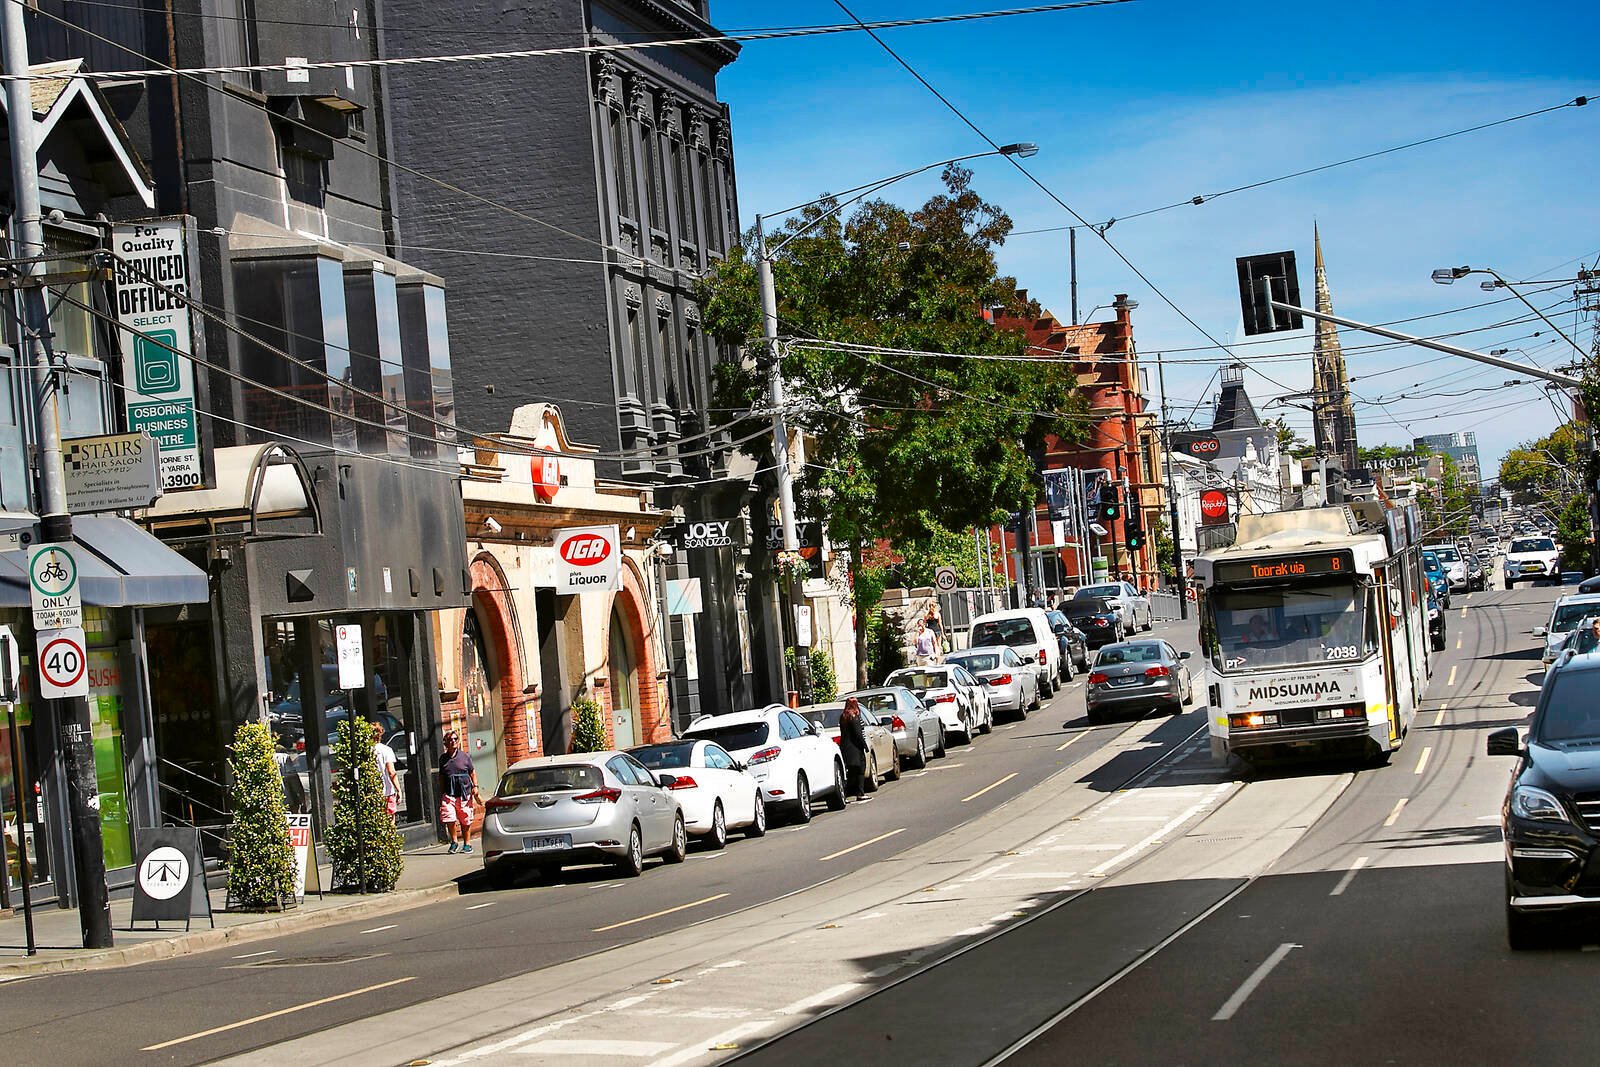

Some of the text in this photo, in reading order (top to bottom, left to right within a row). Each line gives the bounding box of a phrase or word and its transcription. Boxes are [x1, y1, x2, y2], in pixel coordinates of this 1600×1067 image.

[134, 226, 159, 237] For
[122, 238, 174, 252] Quality
[117, 255, 183, 285] SERVICED
[119, 284, 185, 315] OFFICES
[133, 315, 173, 326] SELECT
[134, 404, 187, 418] OSBORNE
[135, 419, 188, 432] BUSINESS
[156, 434, 184, 446] NTRE
[81, 439, 142, 461] STAIRS
[82, 457, 142, 469] HAIR SALON
[167, 465, 191, 473] YARRA
[10, 532, 18, 541] ST
[684, 521, 730, 539] JOEY
[766, 525, 807, 541] JOY
[565, 539, 606, 560] IGA
[684, 537, 731, 549] SCANDIZZO
[1251, 557, 1340, 577] Toorak via 8
[569, 575, 607, 586] LIQUOR
[940, 576, 953, 585] 40
[42, 596, 72, 607] ONLY
[47, 651, 77, 674] 40
[1249, 681, 1341, 700] MIDSUMMA
